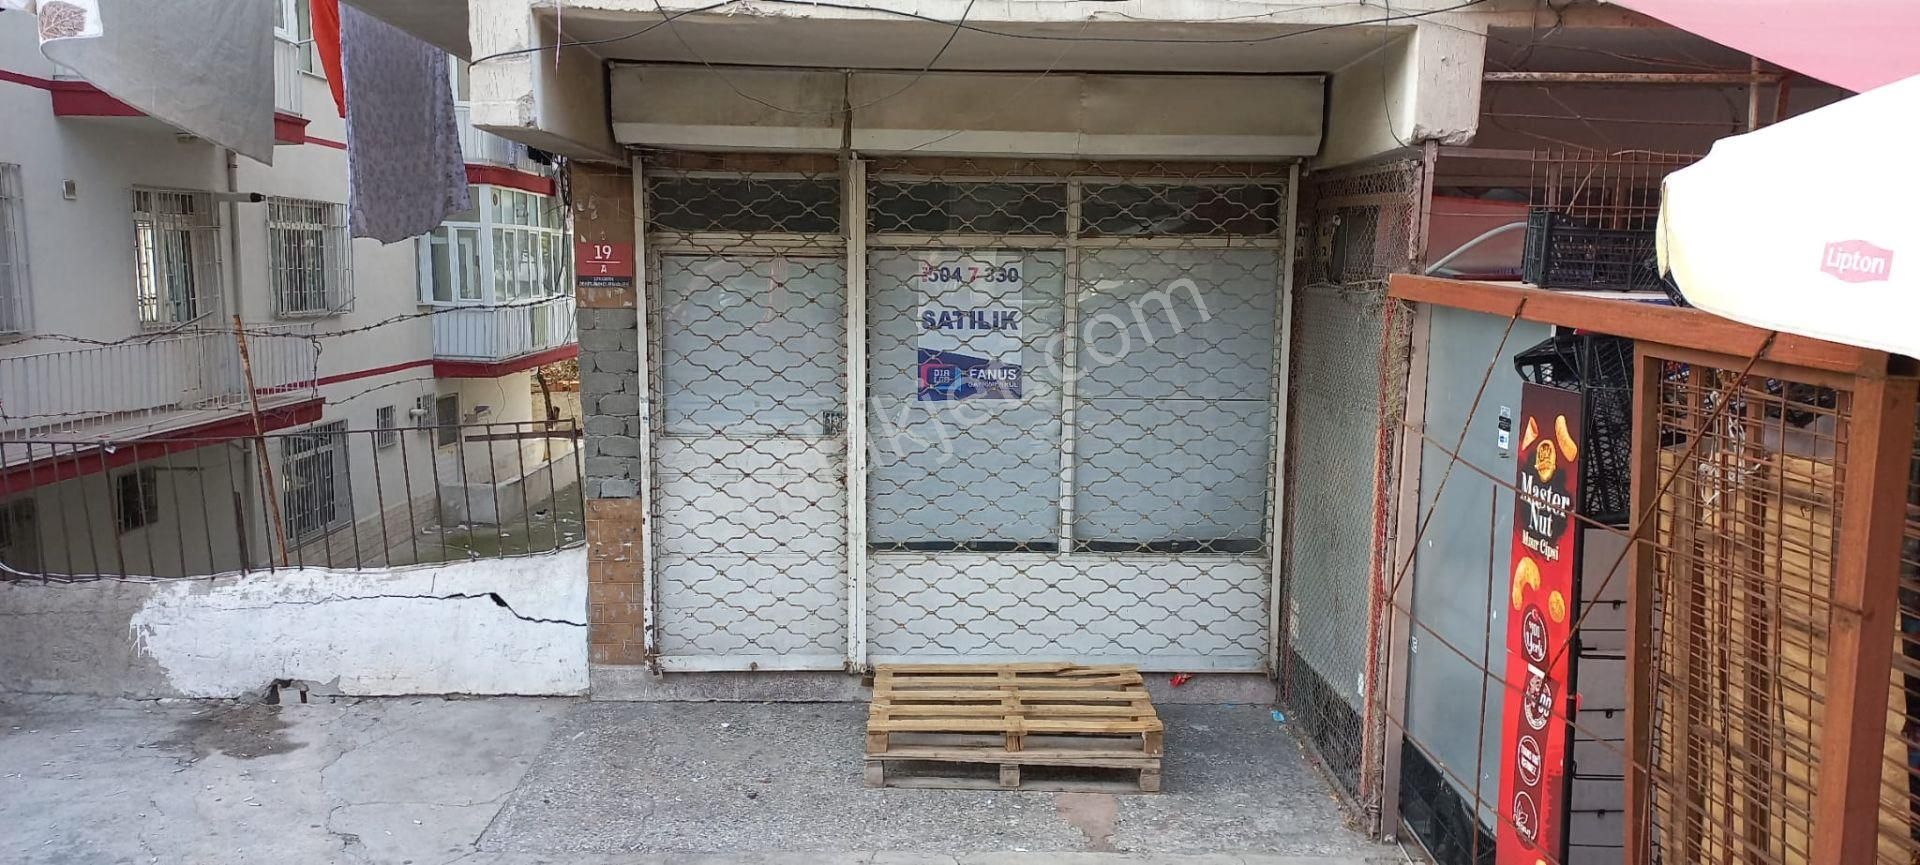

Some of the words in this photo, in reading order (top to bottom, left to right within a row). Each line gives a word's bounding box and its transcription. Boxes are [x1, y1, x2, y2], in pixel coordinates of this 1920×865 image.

[593, 244, 612, 260] 19
[1827, 246, 1886, 275] Lipton
[600, 264, 607, 274] A
[967, 266, 979, 283] 7
[922, 309, 1019, 330] SATILIK
[968, 368, 1018, 381] FANUS
[1521, 472, 1571, 519] Master
[1528, 500, 1554, 538] Nut
